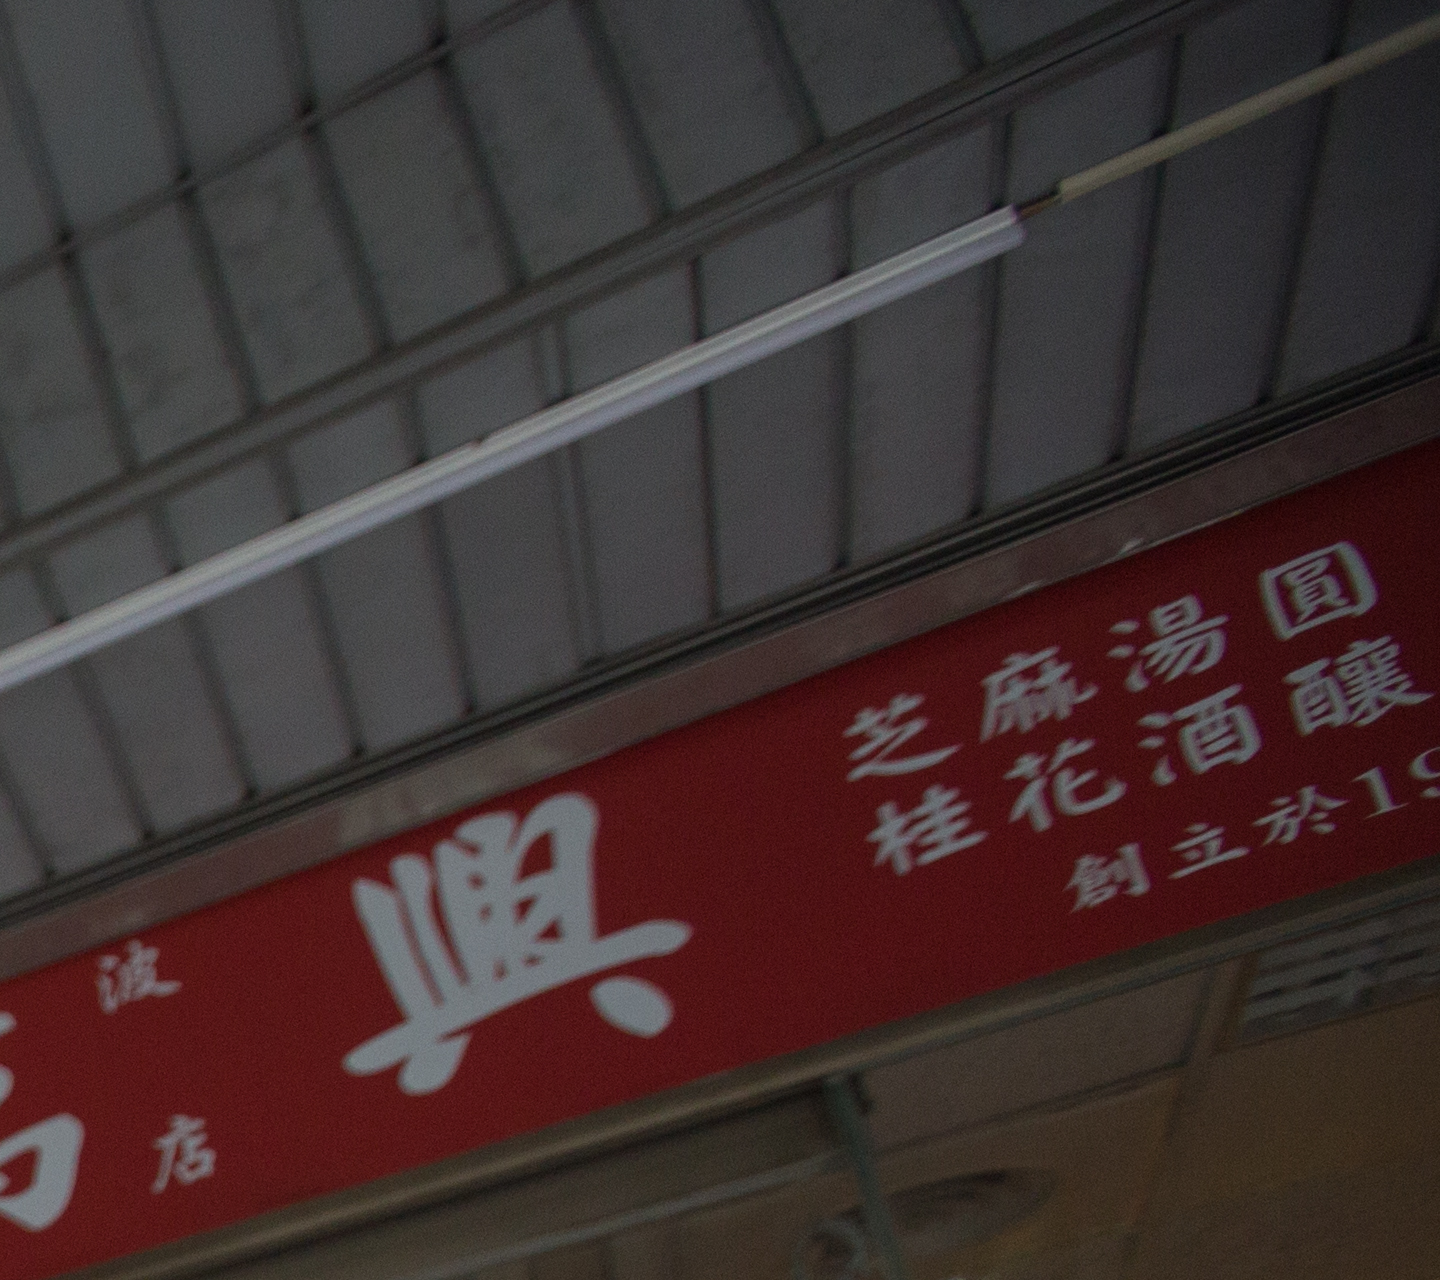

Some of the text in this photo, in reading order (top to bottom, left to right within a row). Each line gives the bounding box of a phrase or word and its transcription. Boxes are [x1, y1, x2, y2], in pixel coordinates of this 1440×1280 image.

[843, 540, 1378, 783] 芝麻湯圓
[866, 635, 1436, 877] 桂花酒釀
